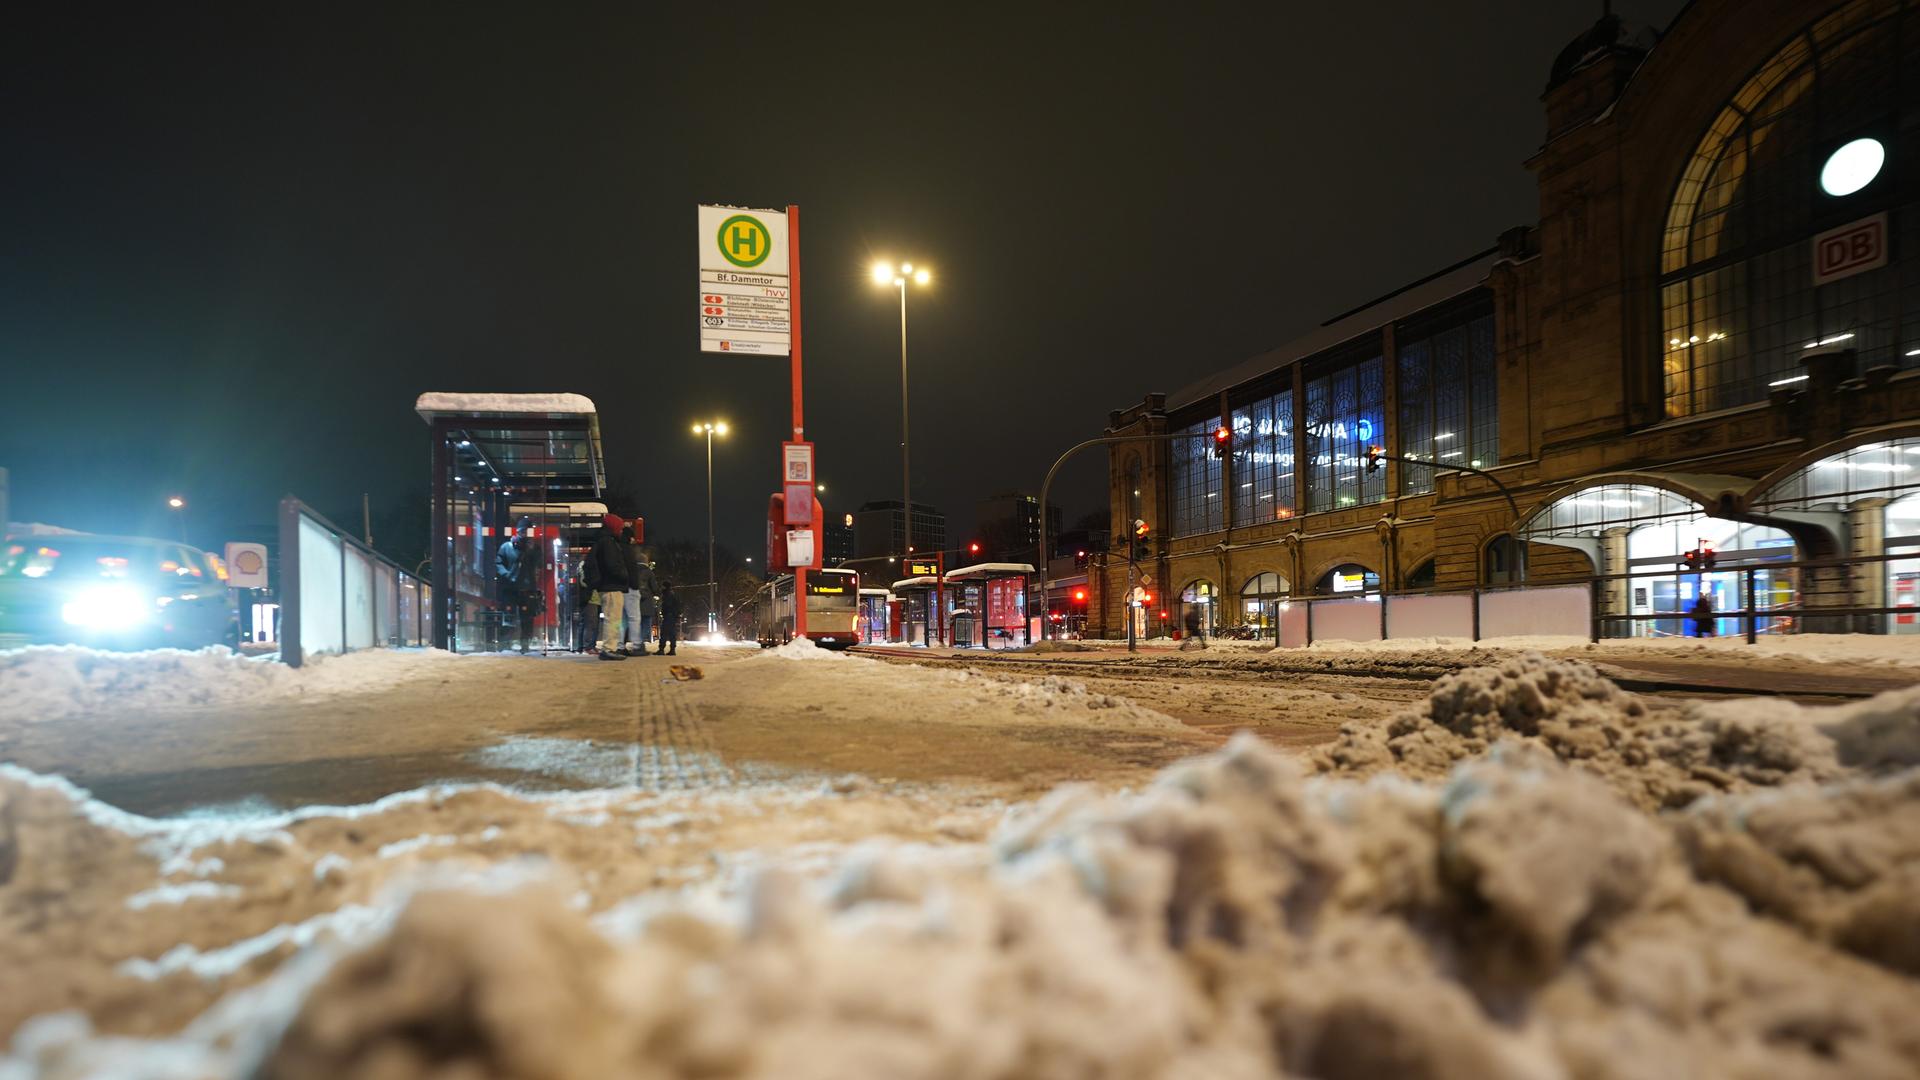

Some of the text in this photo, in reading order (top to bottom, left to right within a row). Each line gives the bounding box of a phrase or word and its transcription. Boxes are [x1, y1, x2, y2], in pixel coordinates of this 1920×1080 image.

[732, 226, 757, 256] H
[1826, 231, 1873, 268] DB
[717, 273, 773, 285] Bf. Dammtor
[766, 288, 786, 297] hvv
